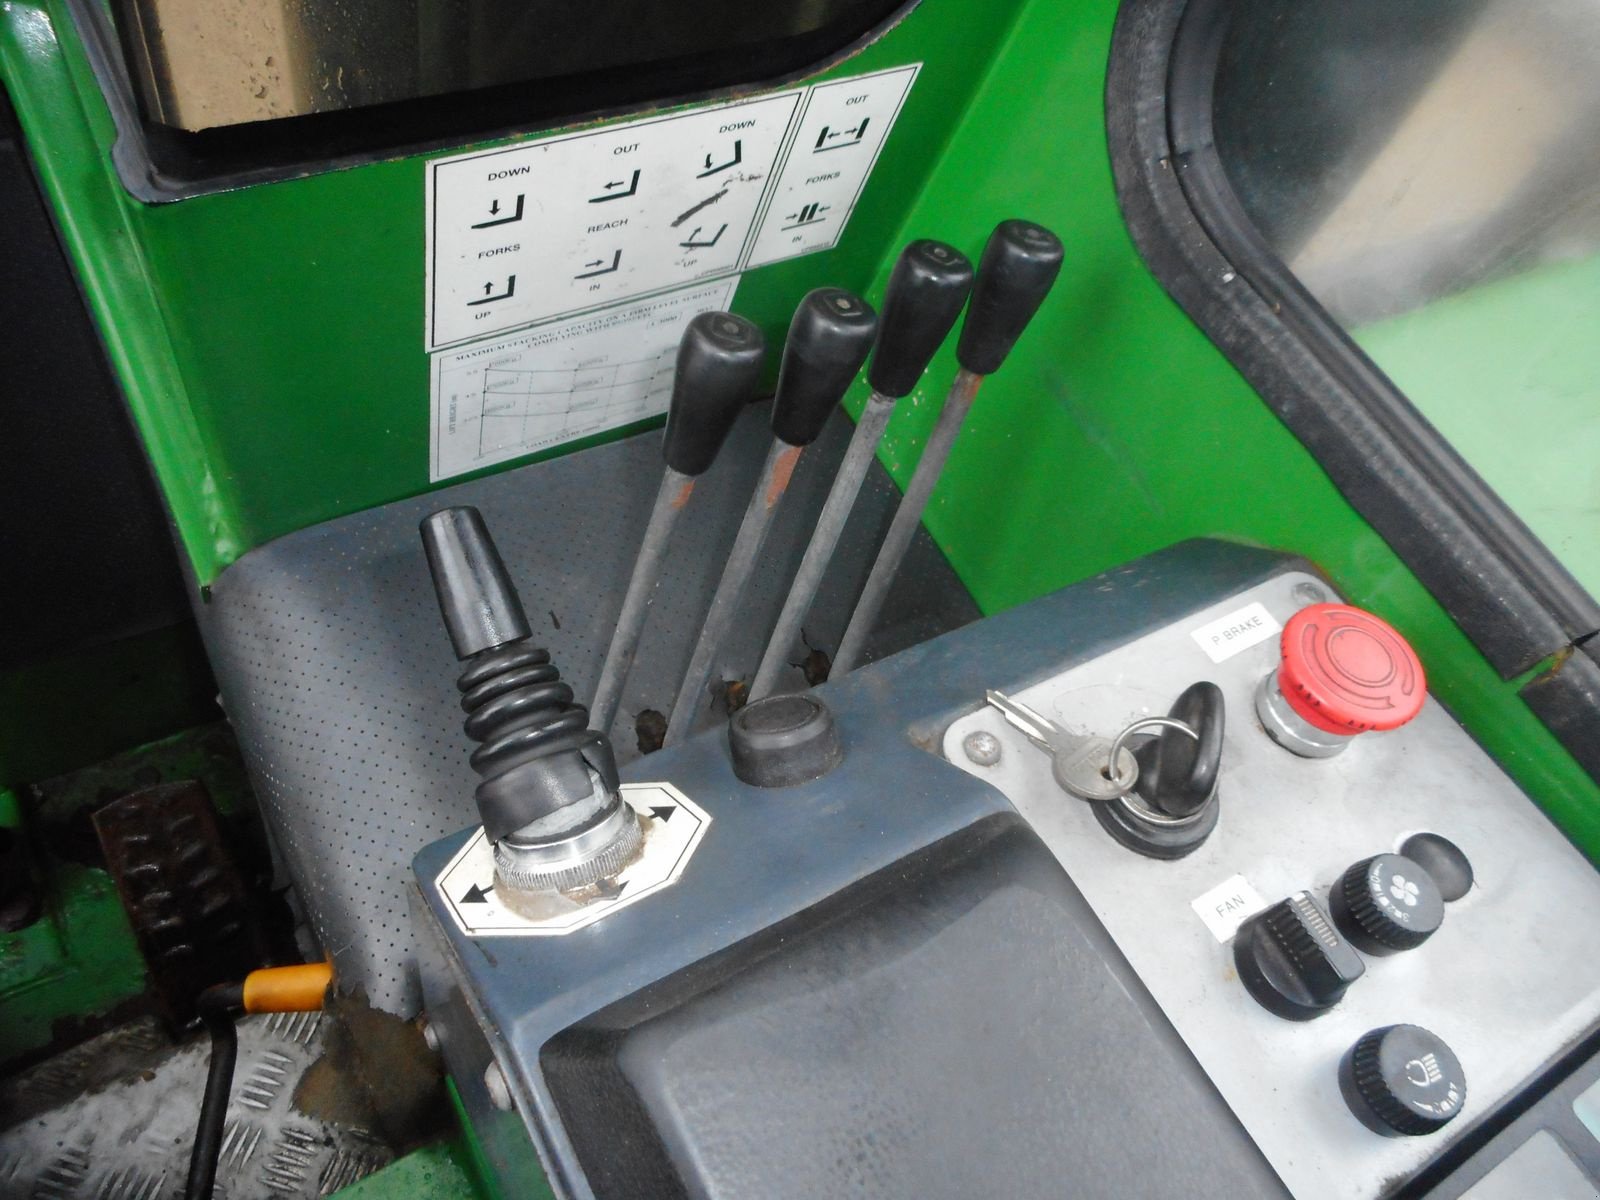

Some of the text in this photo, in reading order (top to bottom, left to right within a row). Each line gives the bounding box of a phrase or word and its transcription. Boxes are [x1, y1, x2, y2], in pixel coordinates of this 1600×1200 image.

[845, 94, 870, 106] OUT
[719, 119, 756, 134] DOWN
[613, 143, 641, 155] OUT
[487, 166, 531, 182] DOWN
[805, 171, 841, 186] FORKS
[587, 218, 629, 234] REACH
[791, 234, 804, 244] IN
[477, 243, 522, 259] FORKS
[682, 258, 698, 269] UP
[589, 283, 601, 292] IN
[474, 311, 491, 321] UP
[455, 343, 506, 361] MAXIMUM
[507, 330, 556, 348] STACKING
[557, 317, 603, 336] CAPACITY
[1222, 615, 1263, 641] BRAKE
[1215, 894, 1245, 918] FAN
